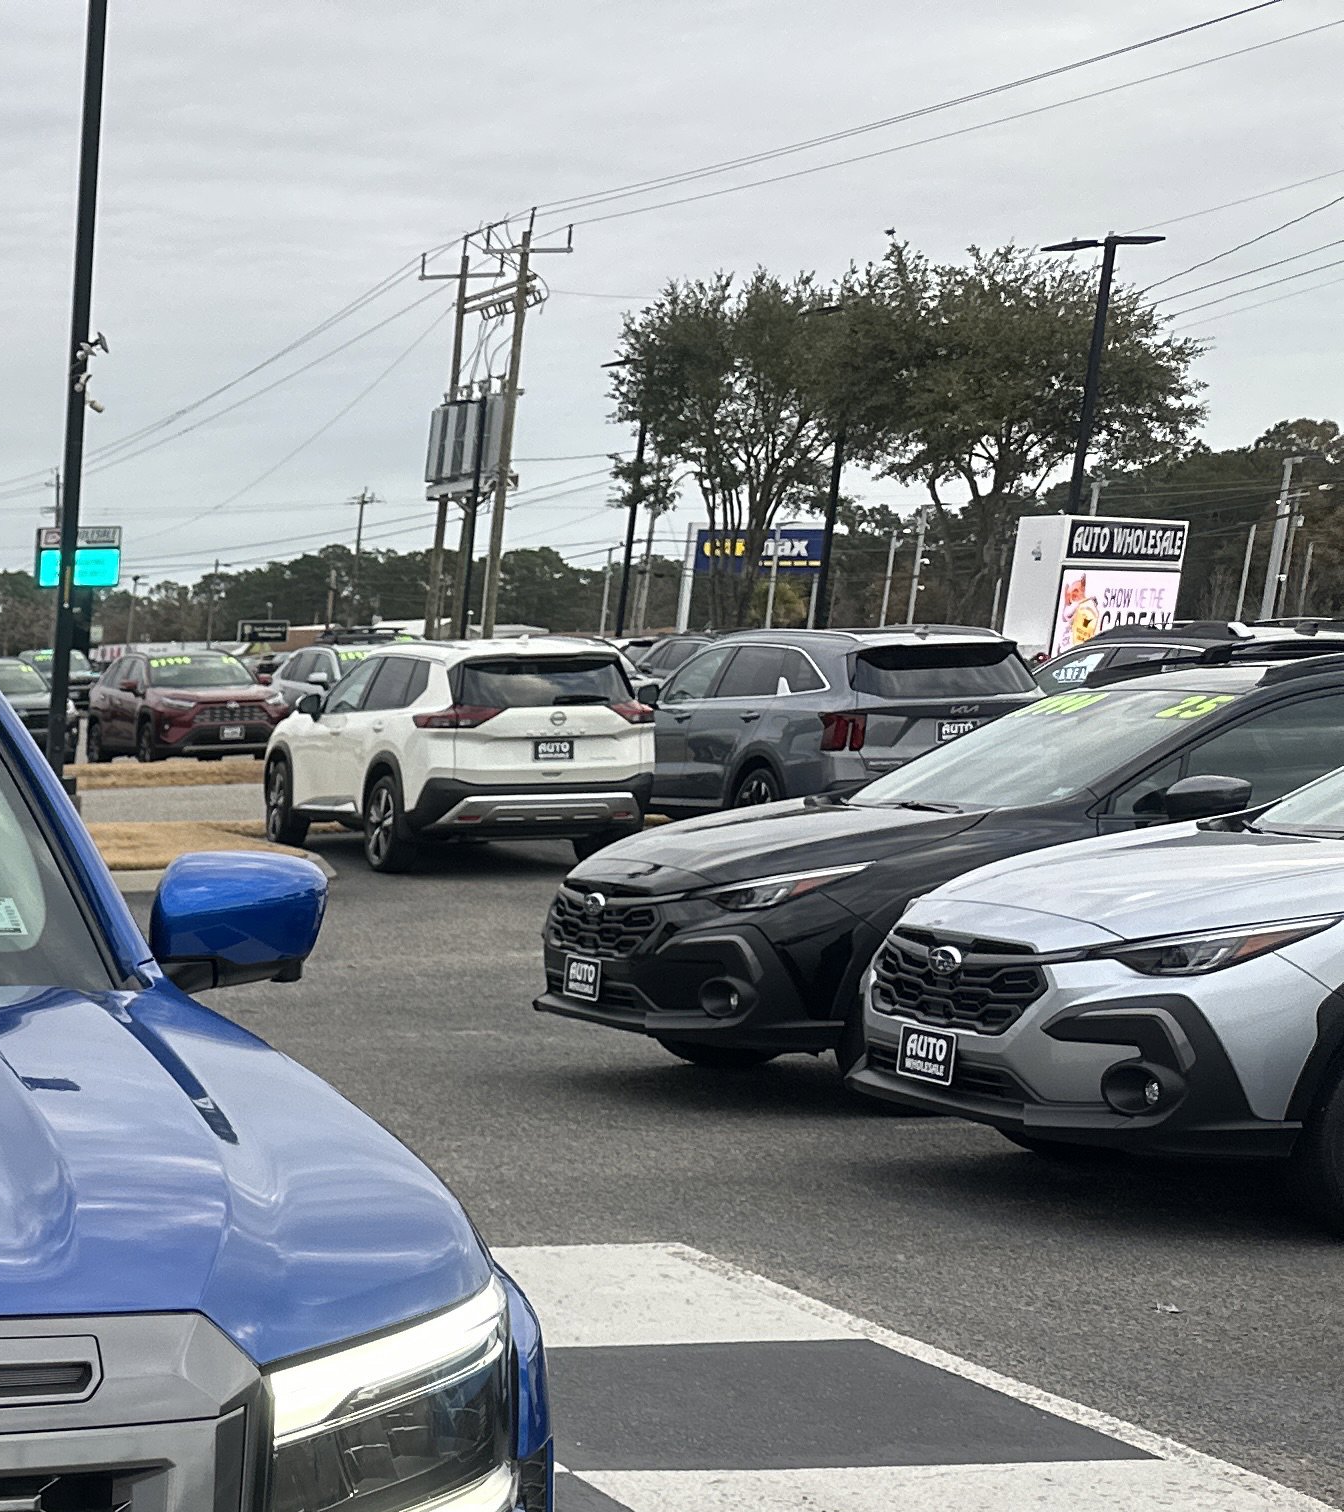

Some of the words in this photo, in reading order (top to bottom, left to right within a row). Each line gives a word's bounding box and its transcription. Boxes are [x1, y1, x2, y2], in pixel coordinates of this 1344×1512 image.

[1073, 527, 1110, 553] AUTO
[1112, 528, 1184, 556] WHOLESALE
[1103, 588, 1133, 608] SHOW
[1052, 666, 1088, 681] CARFA
[1155, 695, 1235, 719] 25
[942, 721, 974, 734] AUTO
[538, 741, 570, 753] AUTO
[569, 961, 595, 983] AUTO
[906, 1033, 947, 1062] AUTO
[905, 1057, 945, 1077] WHOLESALE
